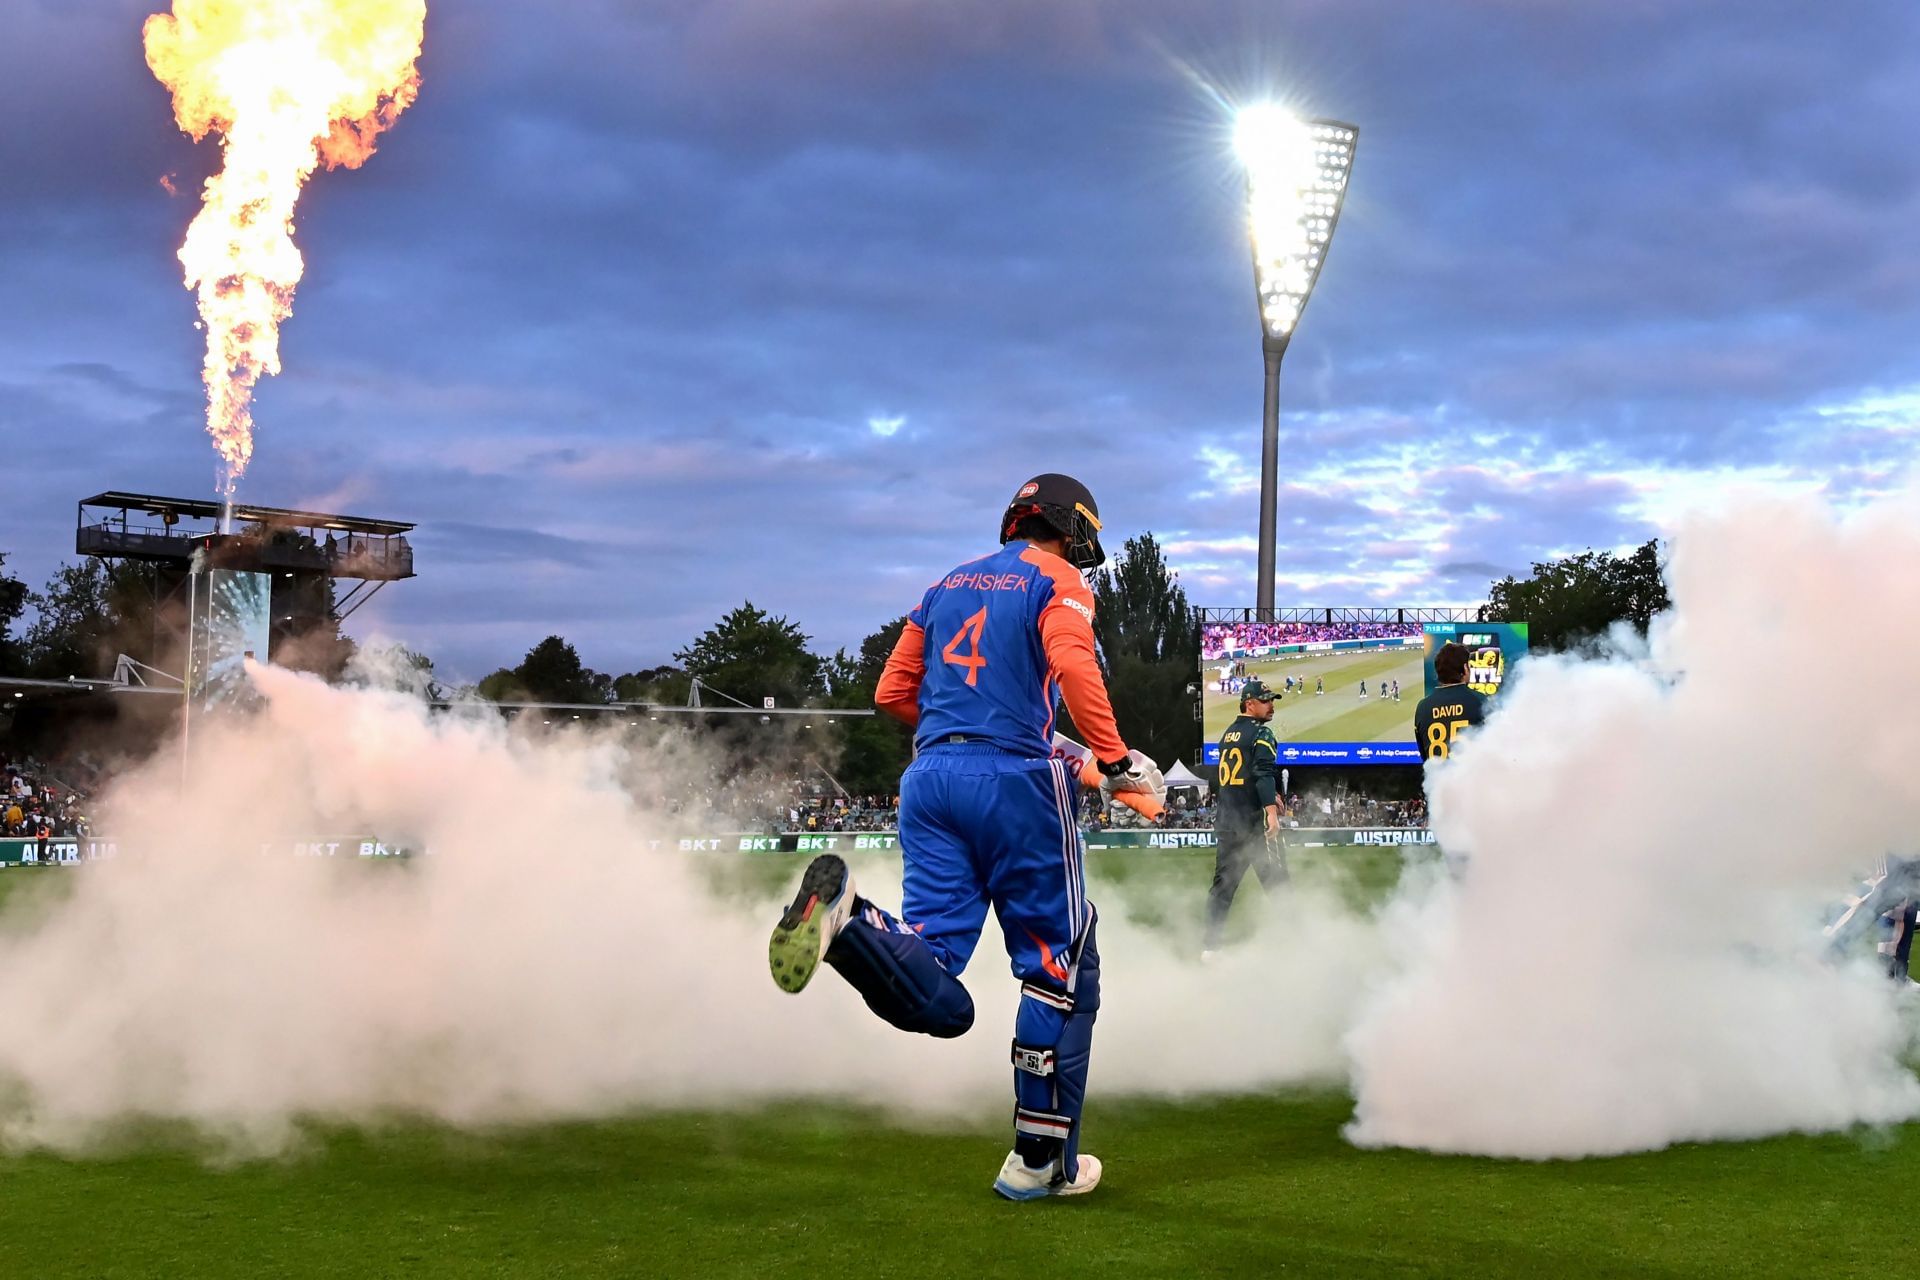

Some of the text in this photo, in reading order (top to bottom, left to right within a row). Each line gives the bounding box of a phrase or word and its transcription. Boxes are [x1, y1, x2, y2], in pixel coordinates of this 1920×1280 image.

[943, 573, 1029, 592] ABHISHEK
[942, 605, 987, 687] 4
[1432, 704, 1464, 719] DAVID
[1218, 747, 1244, 786] 62
[797, 837, 838, 849] BKT
[854, 837, 896, 849] BKT
[1150, 833, 1217, 845] AUSTRAL
[1353, 831, 1436, 844] AUSTRALIA
[679, 839, 721, 850] BKT
[739, 838, 781, 850] BKT
